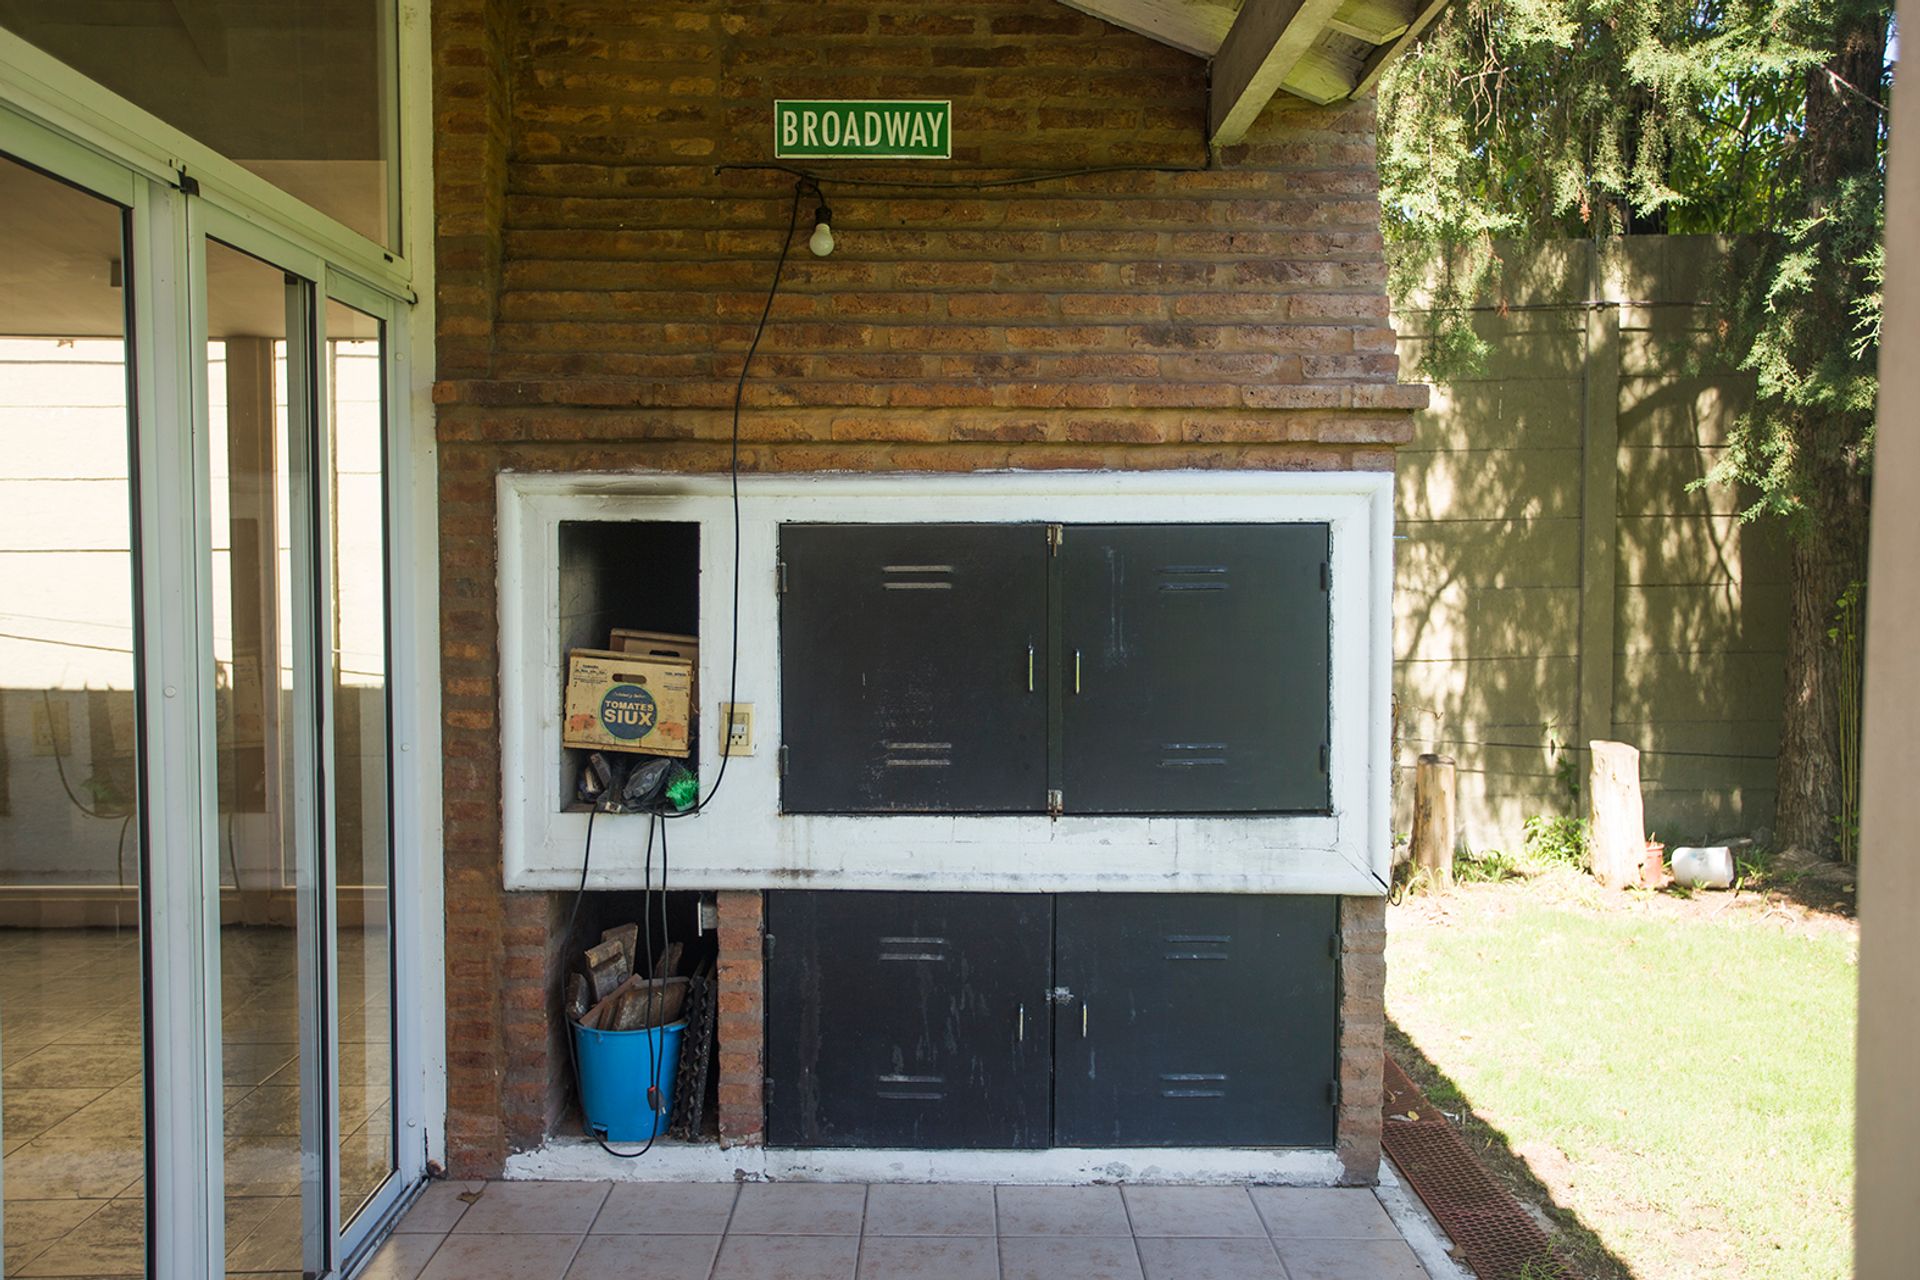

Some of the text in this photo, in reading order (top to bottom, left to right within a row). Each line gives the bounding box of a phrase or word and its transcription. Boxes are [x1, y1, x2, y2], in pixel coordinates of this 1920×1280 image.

[783, 111, 944, 147] BROADWAY
[605, 700, 654, 712] TOMATES
[604, 709, 653, 727] SIUX
